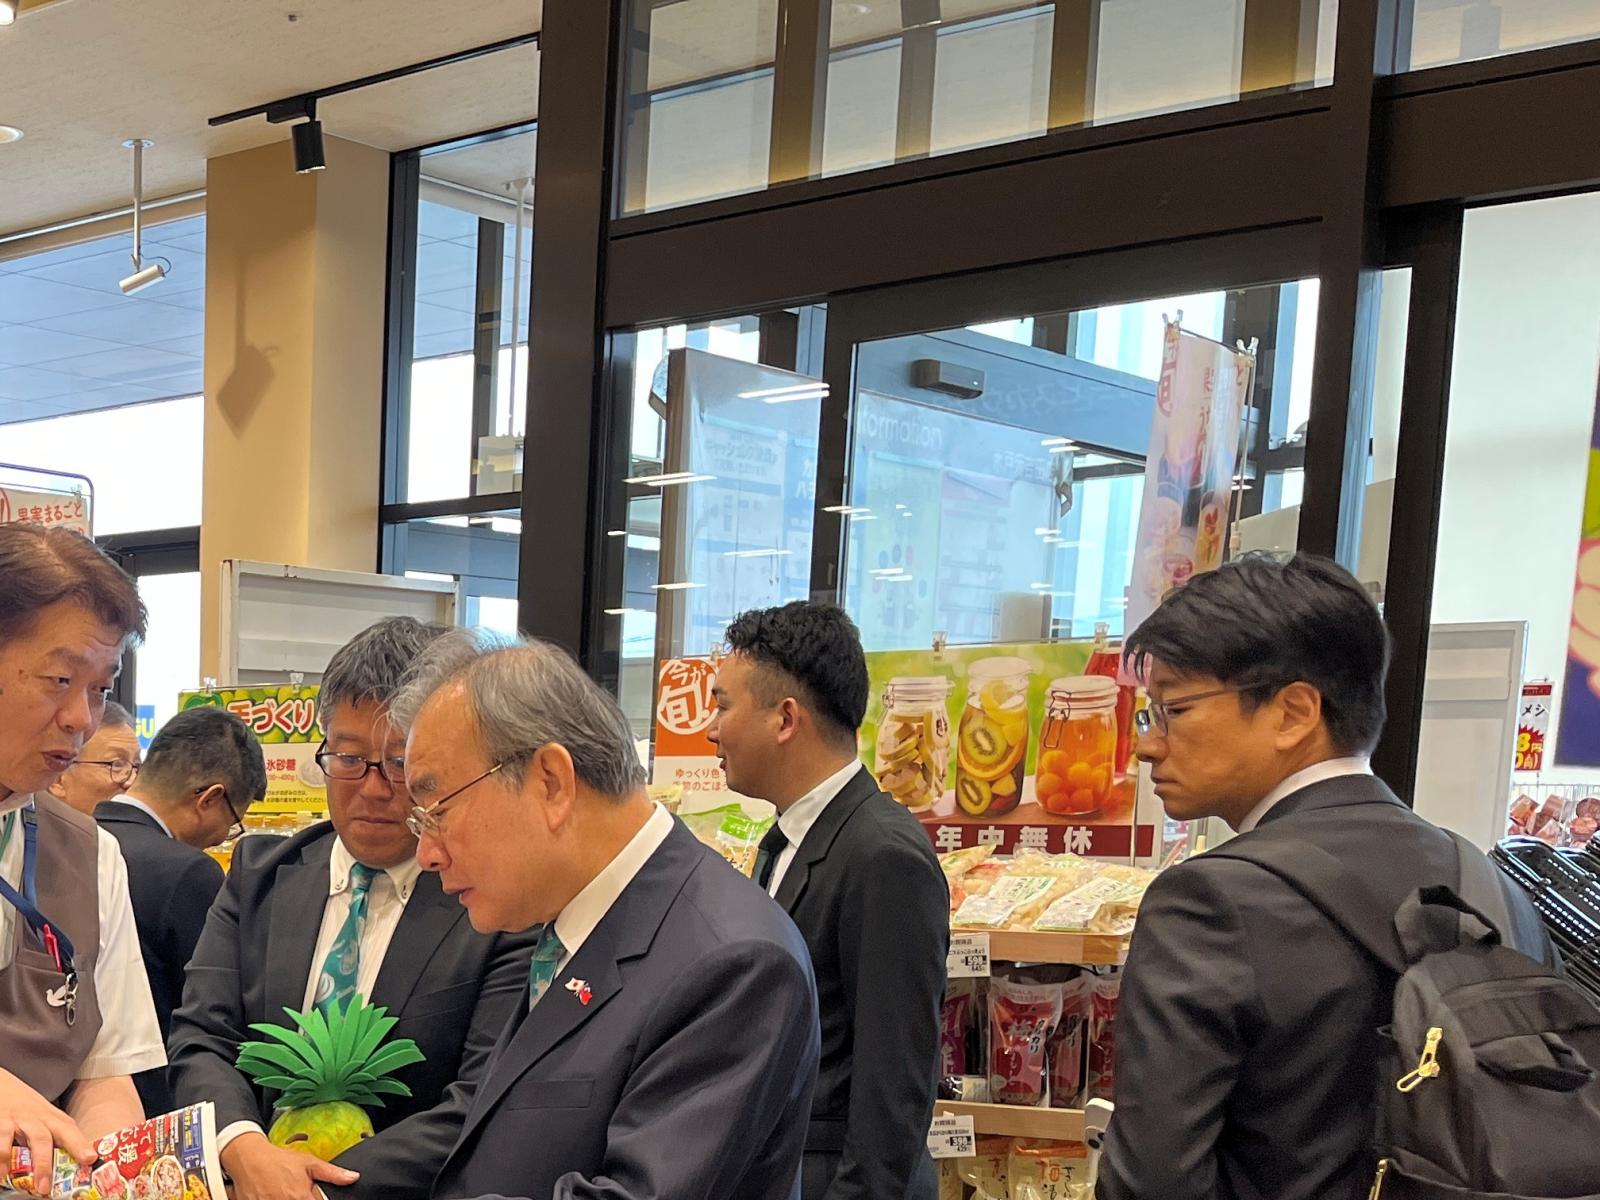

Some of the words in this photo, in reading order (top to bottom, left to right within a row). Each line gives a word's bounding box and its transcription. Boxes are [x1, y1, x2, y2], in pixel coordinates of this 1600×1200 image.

[17, 501, 84, 523] 果実まるごと
[227, 698, 314, 734] 手づくり
[266, 758, 297, 771] 氷砂糖
[935, 825, 1093, 855] 年中無休
